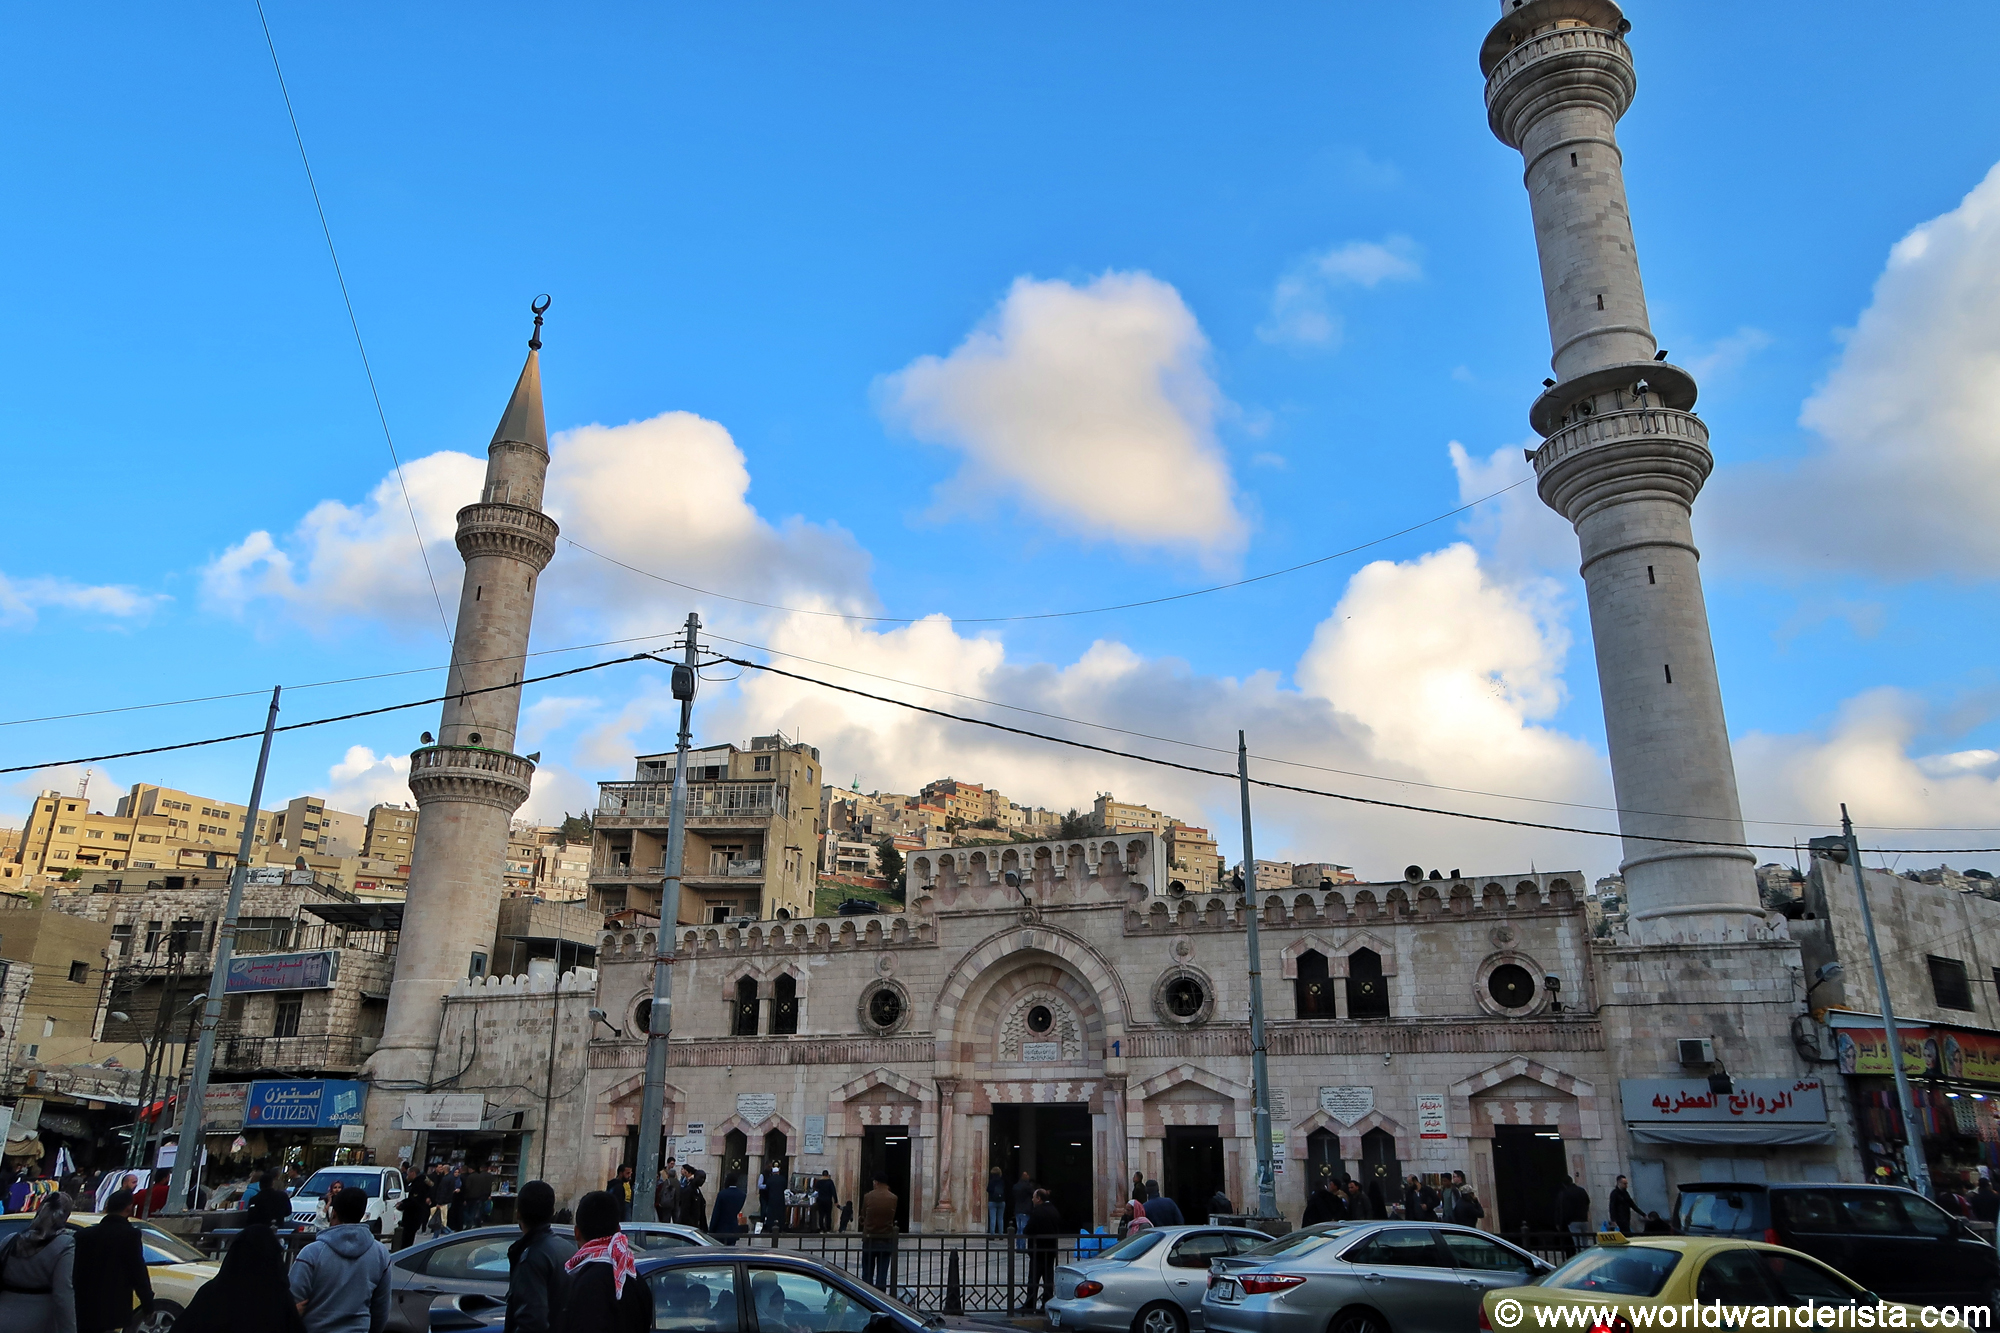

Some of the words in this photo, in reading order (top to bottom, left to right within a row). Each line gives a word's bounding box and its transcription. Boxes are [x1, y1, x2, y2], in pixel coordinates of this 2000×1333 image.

[1111, 1040, 1120, 1057] 1
[1793, 1080, 1819, 1092] معرض
[264, 1087, 322, 1104] سيتيزن
[1728, 1090, 1793, 1115] الروائح
[261, 1104, 318, 1121] CITIZEN
[1600, 1234, 1617, 1242] TAXI
